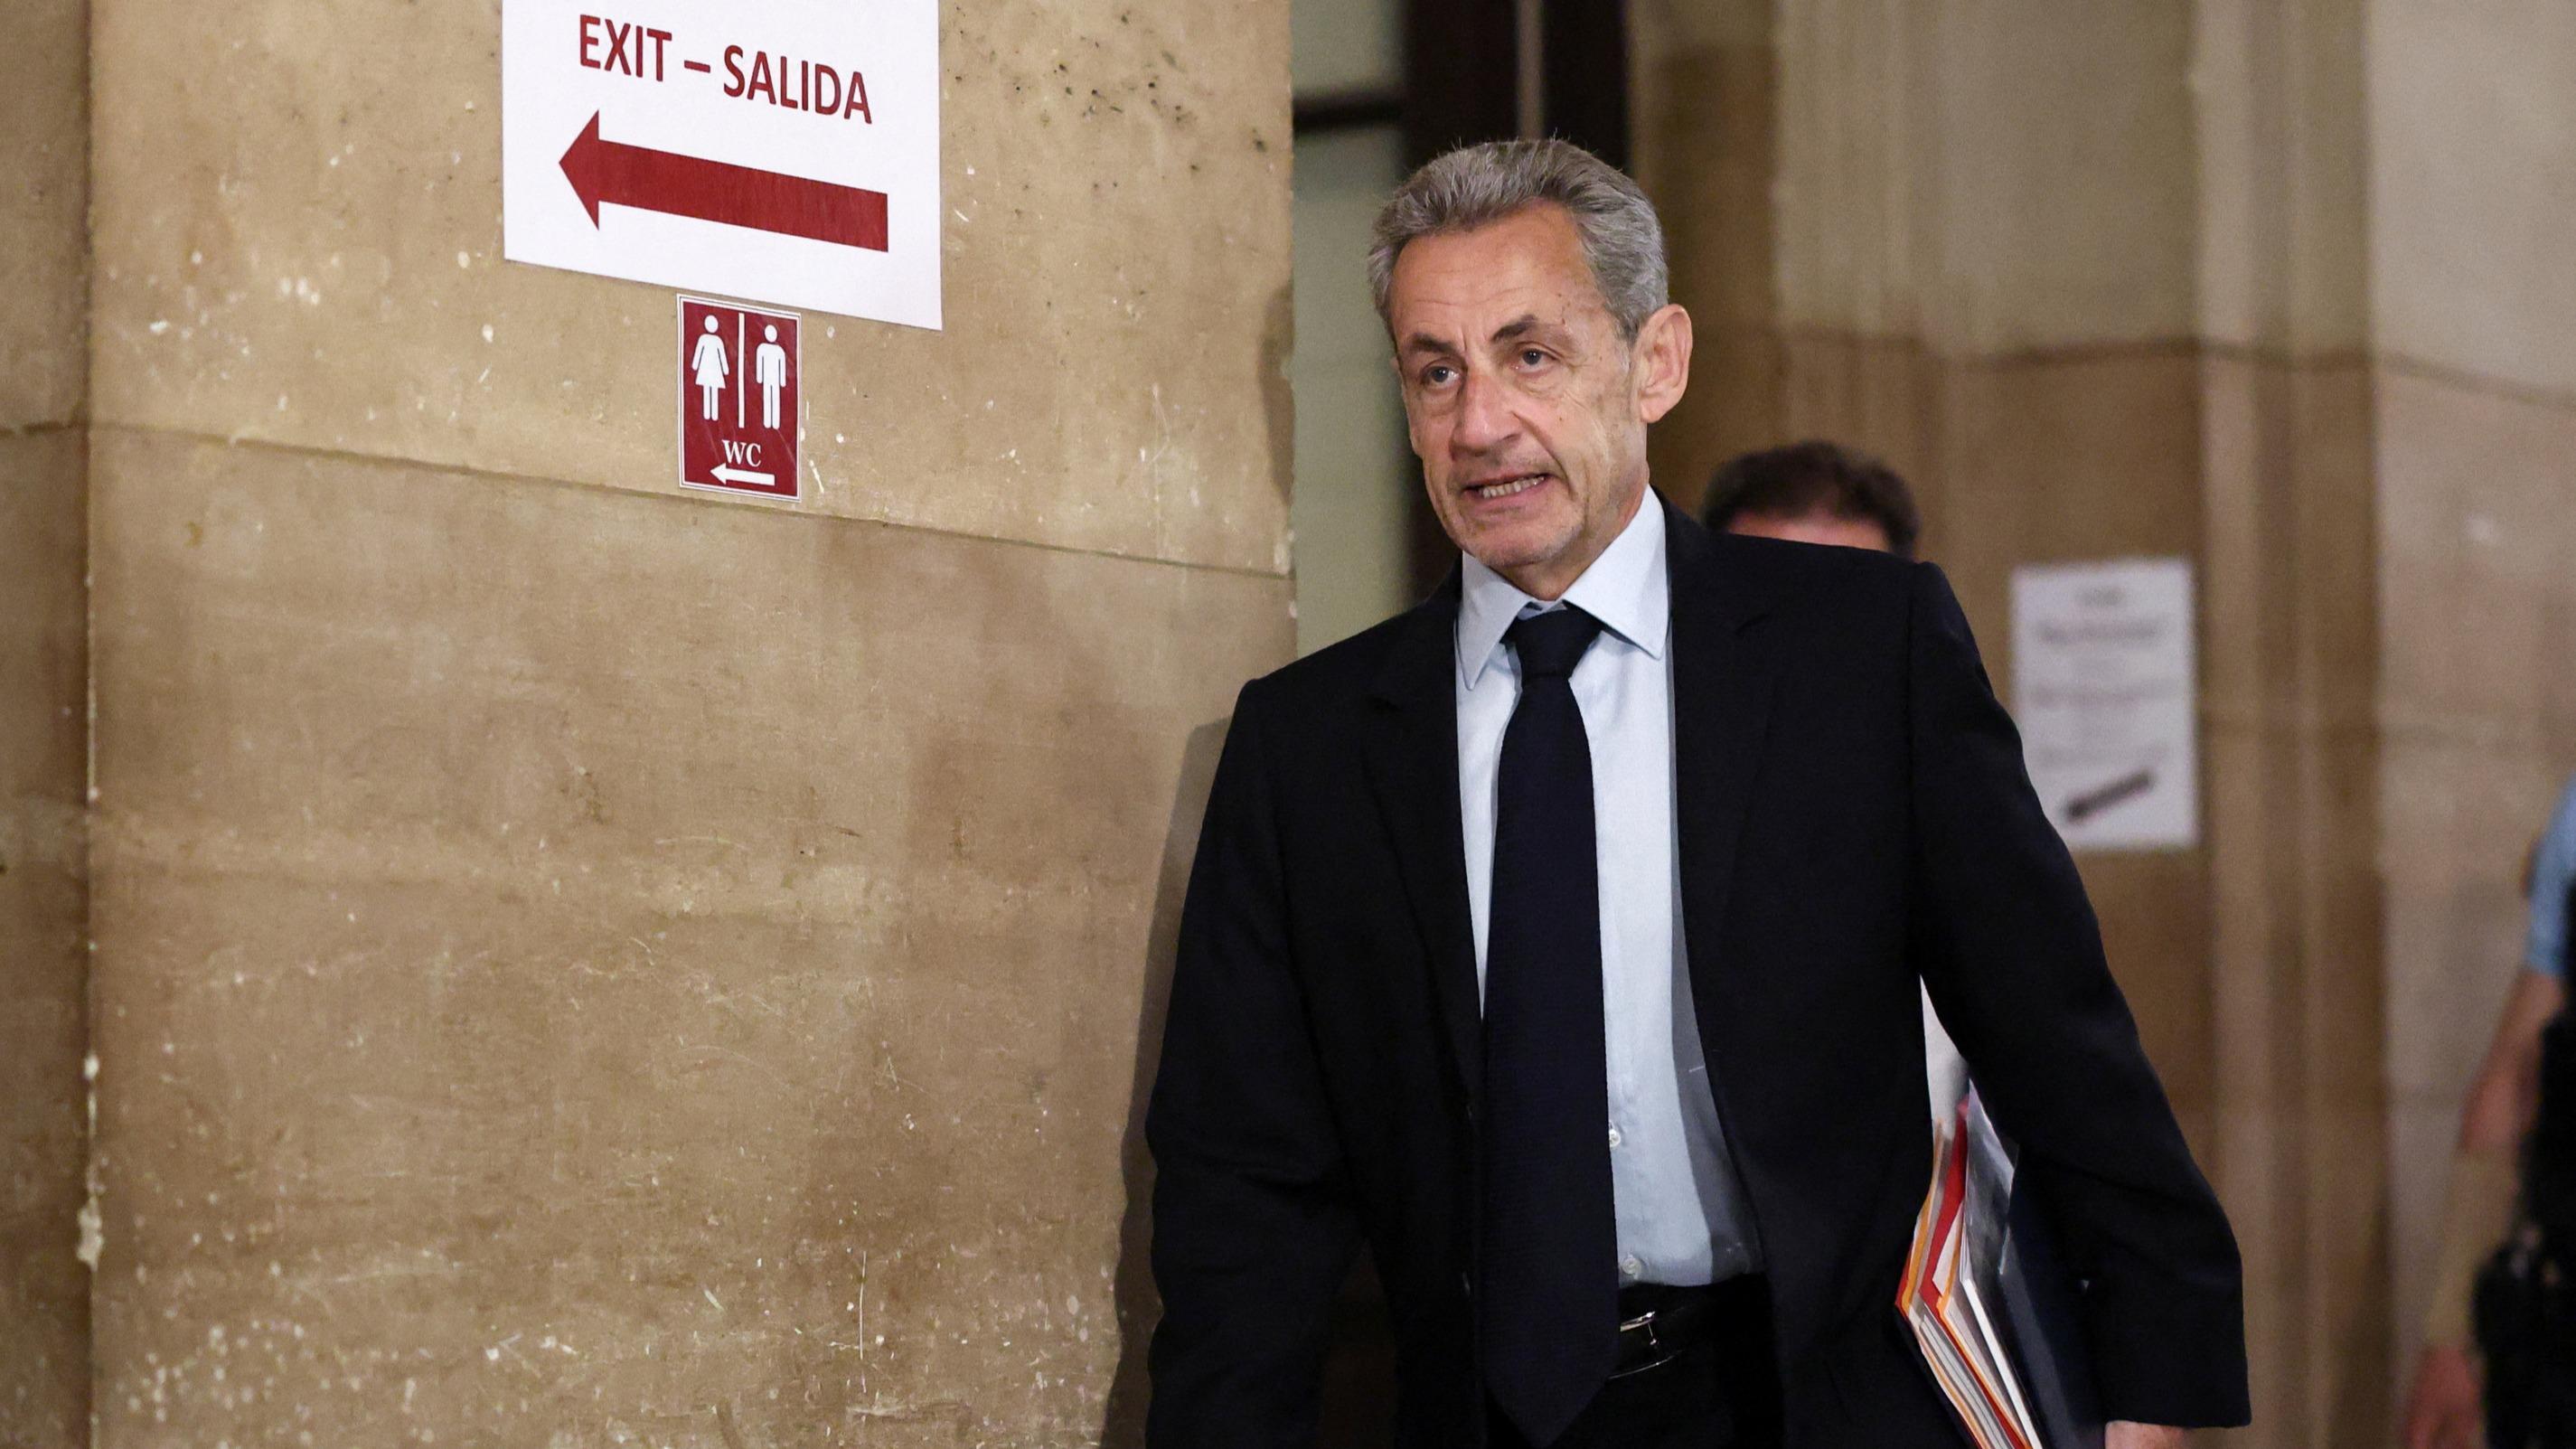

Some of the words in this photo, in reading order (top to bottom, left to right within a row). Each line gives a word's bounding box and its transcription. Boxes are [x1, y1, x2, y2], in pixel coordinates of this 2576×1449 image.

[579, 14, 672, 81] EXIT
[724, 44, 872, 124] SALIDA
[722, 439, 761, 467] WC
